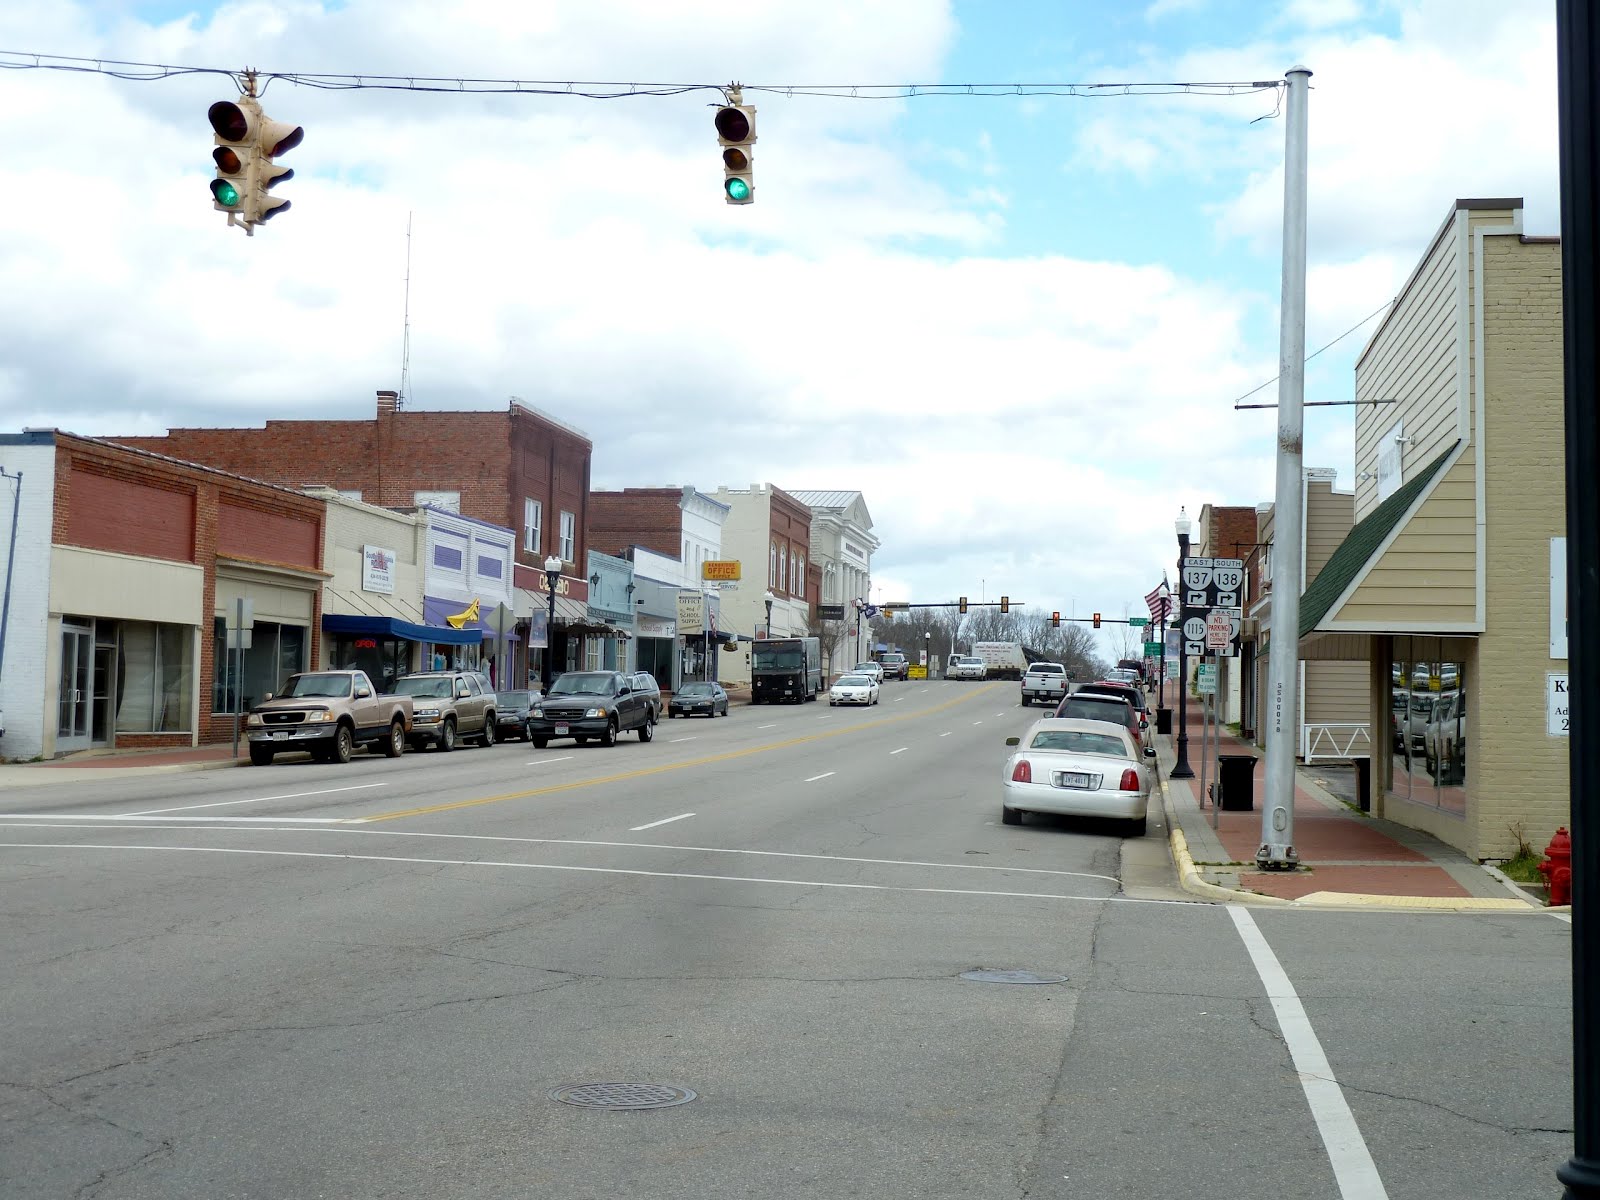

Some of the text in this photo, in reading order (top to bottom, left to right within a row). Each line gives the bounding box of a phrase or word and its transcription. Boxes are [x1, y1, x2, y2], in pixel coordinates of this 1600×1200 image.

[1188, 572, 1208, 585] 137
[1217, 573, 1238, 586] 138
[1213, 616, 1223, 624] NO
[1187, 623, 1204, 635] 1115
[1208, 624, 1229, 632] PARKING
[355, 640, 376, 648] OPEN
[1554, 680, 1568, 692] K
